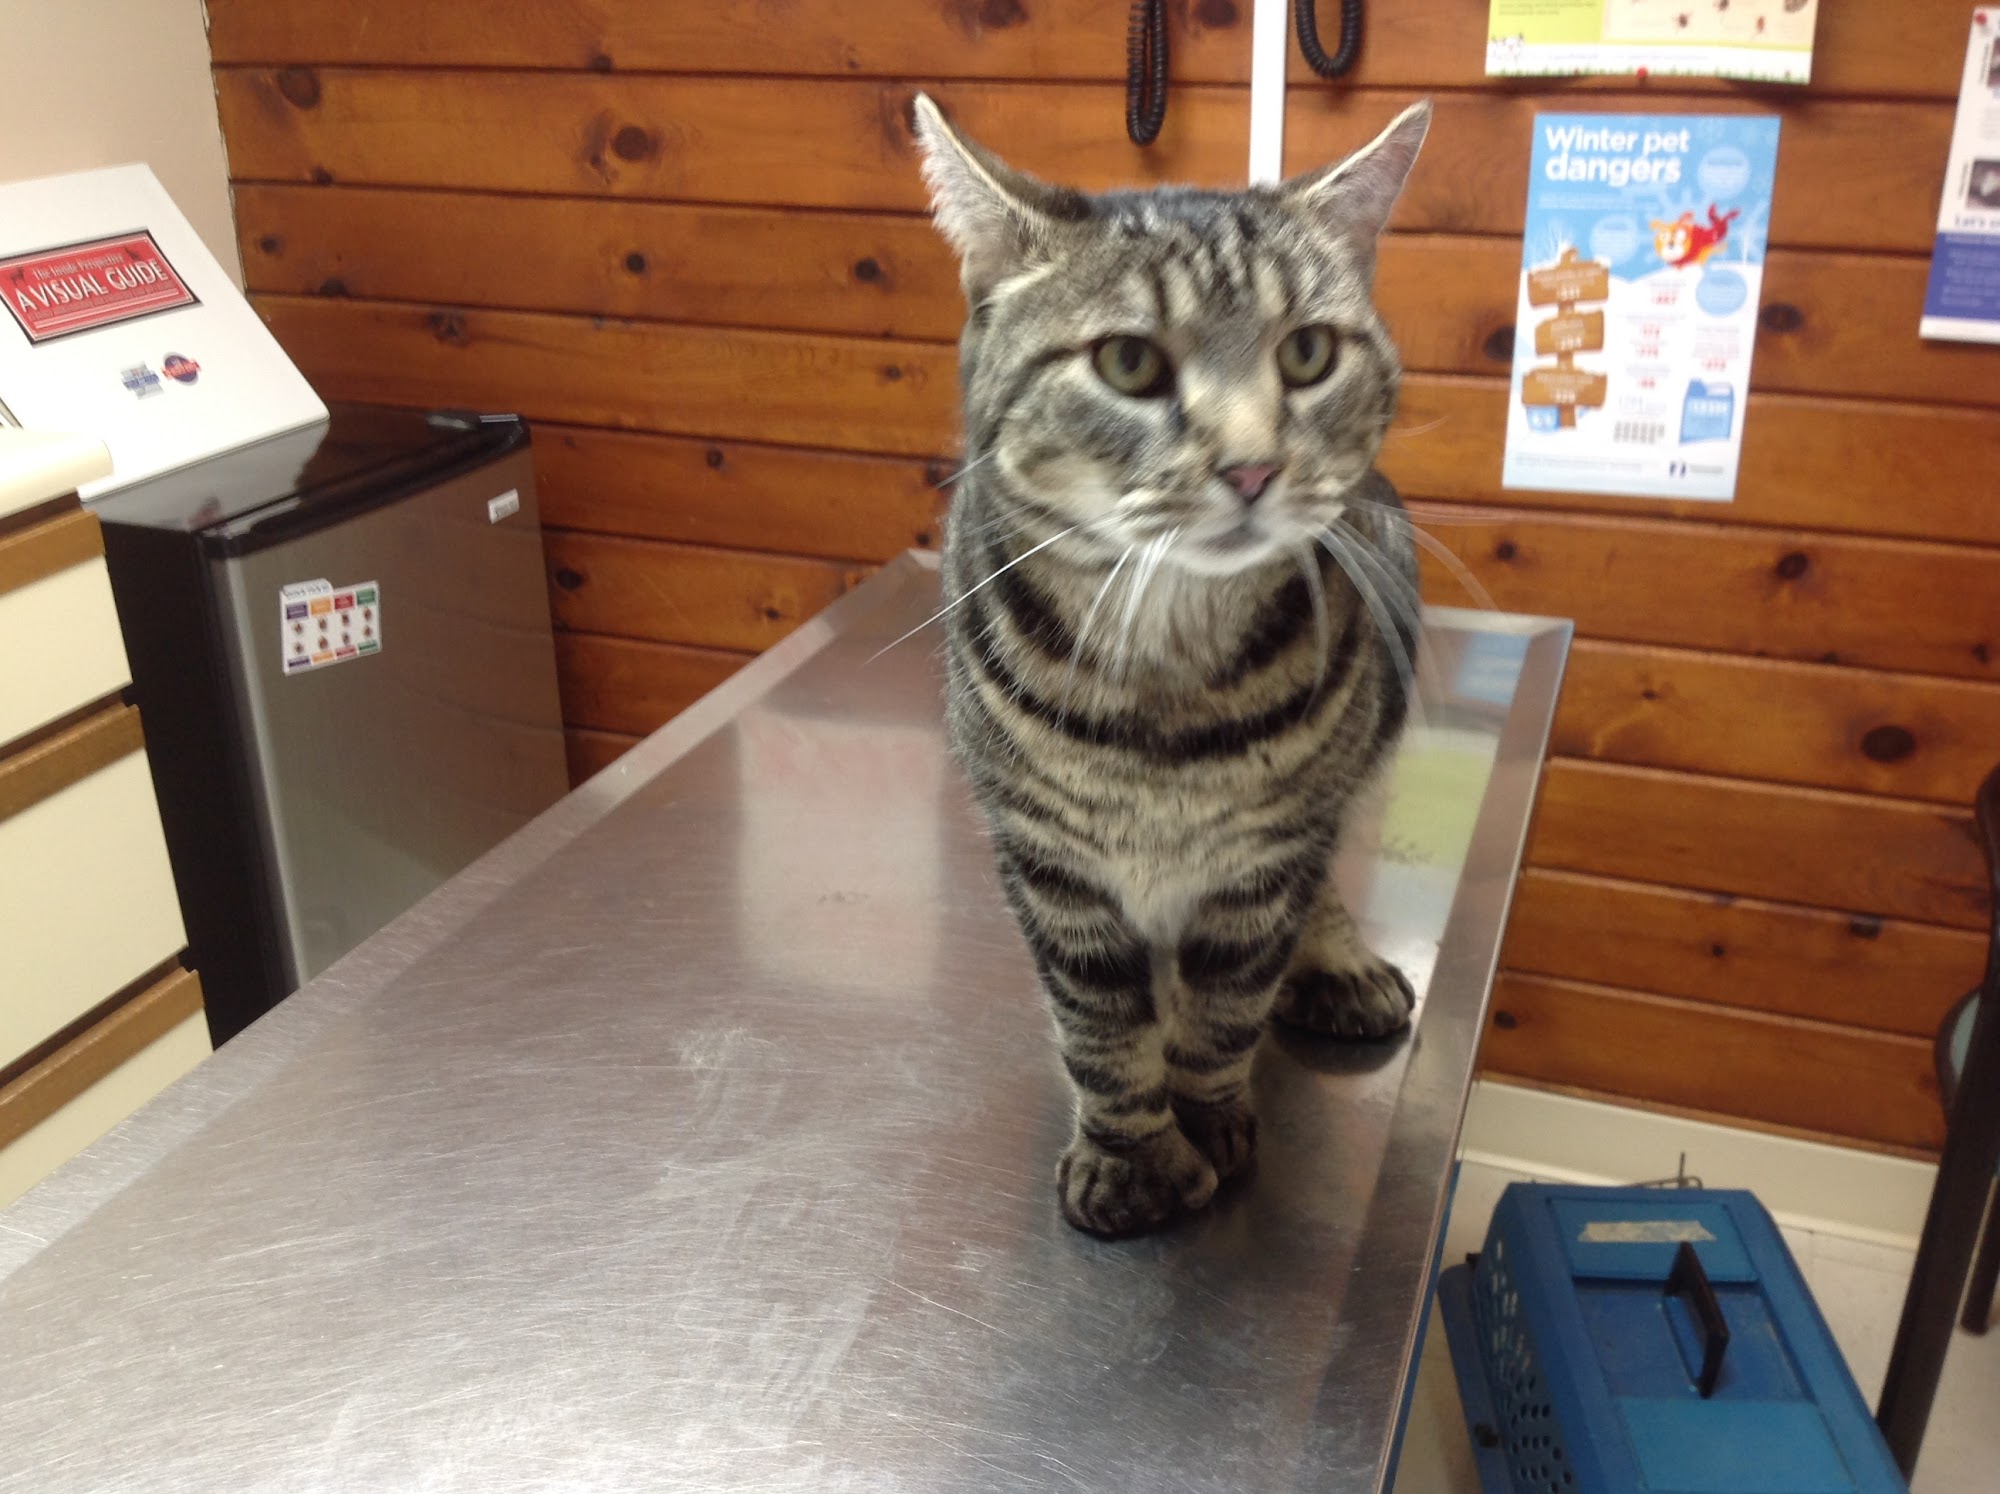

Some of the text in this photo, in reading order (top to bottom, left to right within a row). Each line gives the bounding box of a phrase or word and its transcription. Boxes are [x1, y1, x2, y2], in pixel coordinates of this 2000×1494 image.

[1545, 126, 1690, 156] Winter pet
[1545, 153, 1682, 188] dangers
[32, 251, 126, 282] The Inside Perspective
[15, 258, 169, 313] A VISUAL GUIDE
